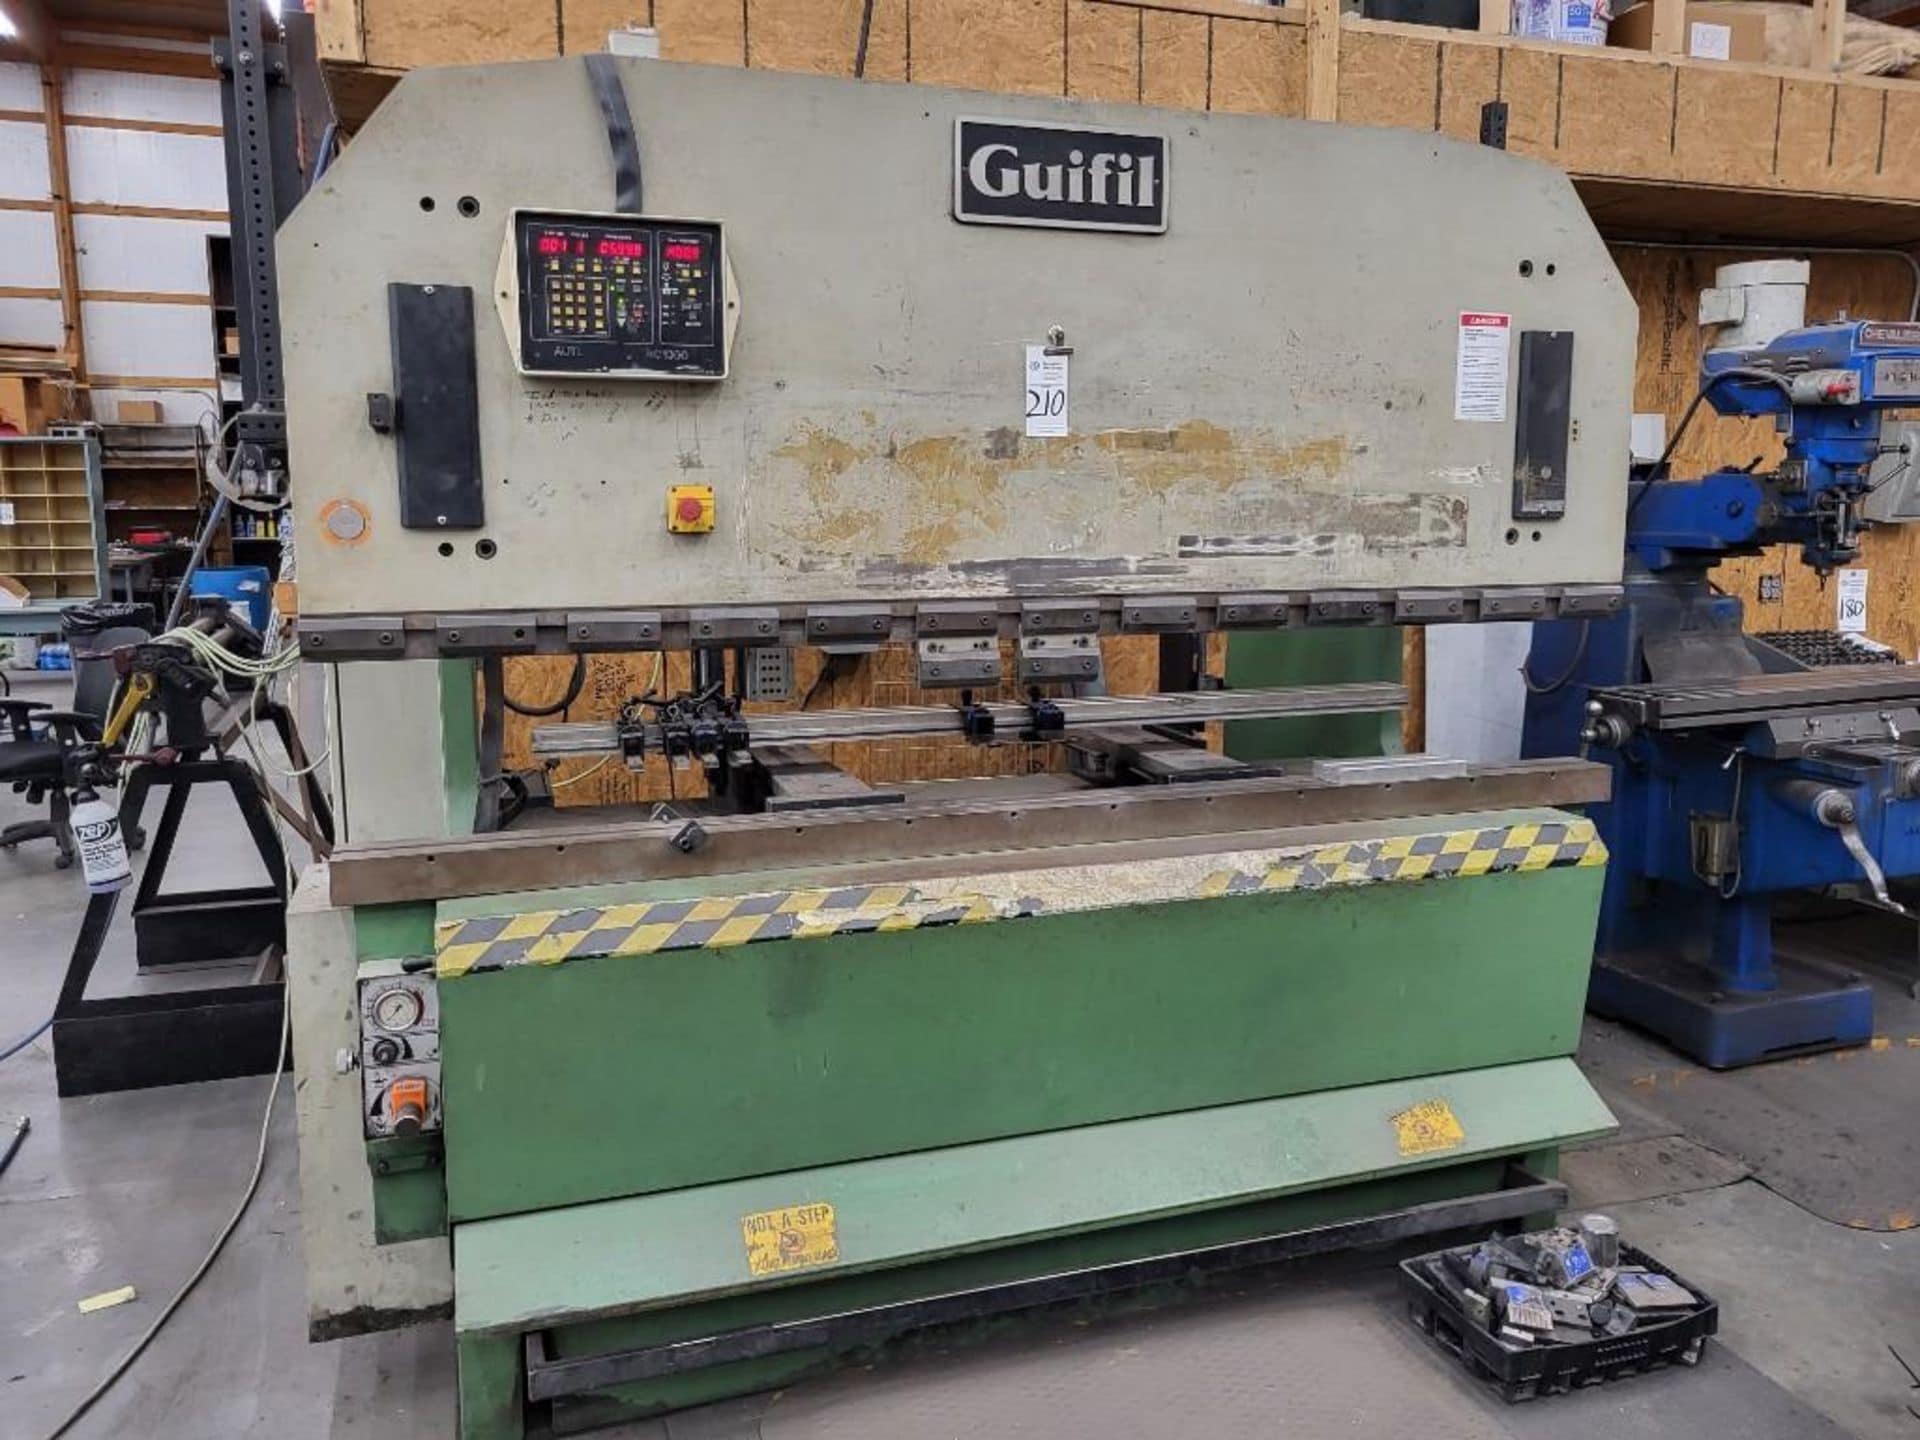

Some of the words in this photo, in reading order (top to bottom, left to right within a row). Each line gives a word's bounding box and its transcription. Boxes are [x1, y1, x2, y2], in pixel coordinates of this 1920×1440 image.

[969, 144, 1154, 206] Guifil
[1025, 389, 1065, 417] 210
[798, 1206, 829, 1226] STEP
